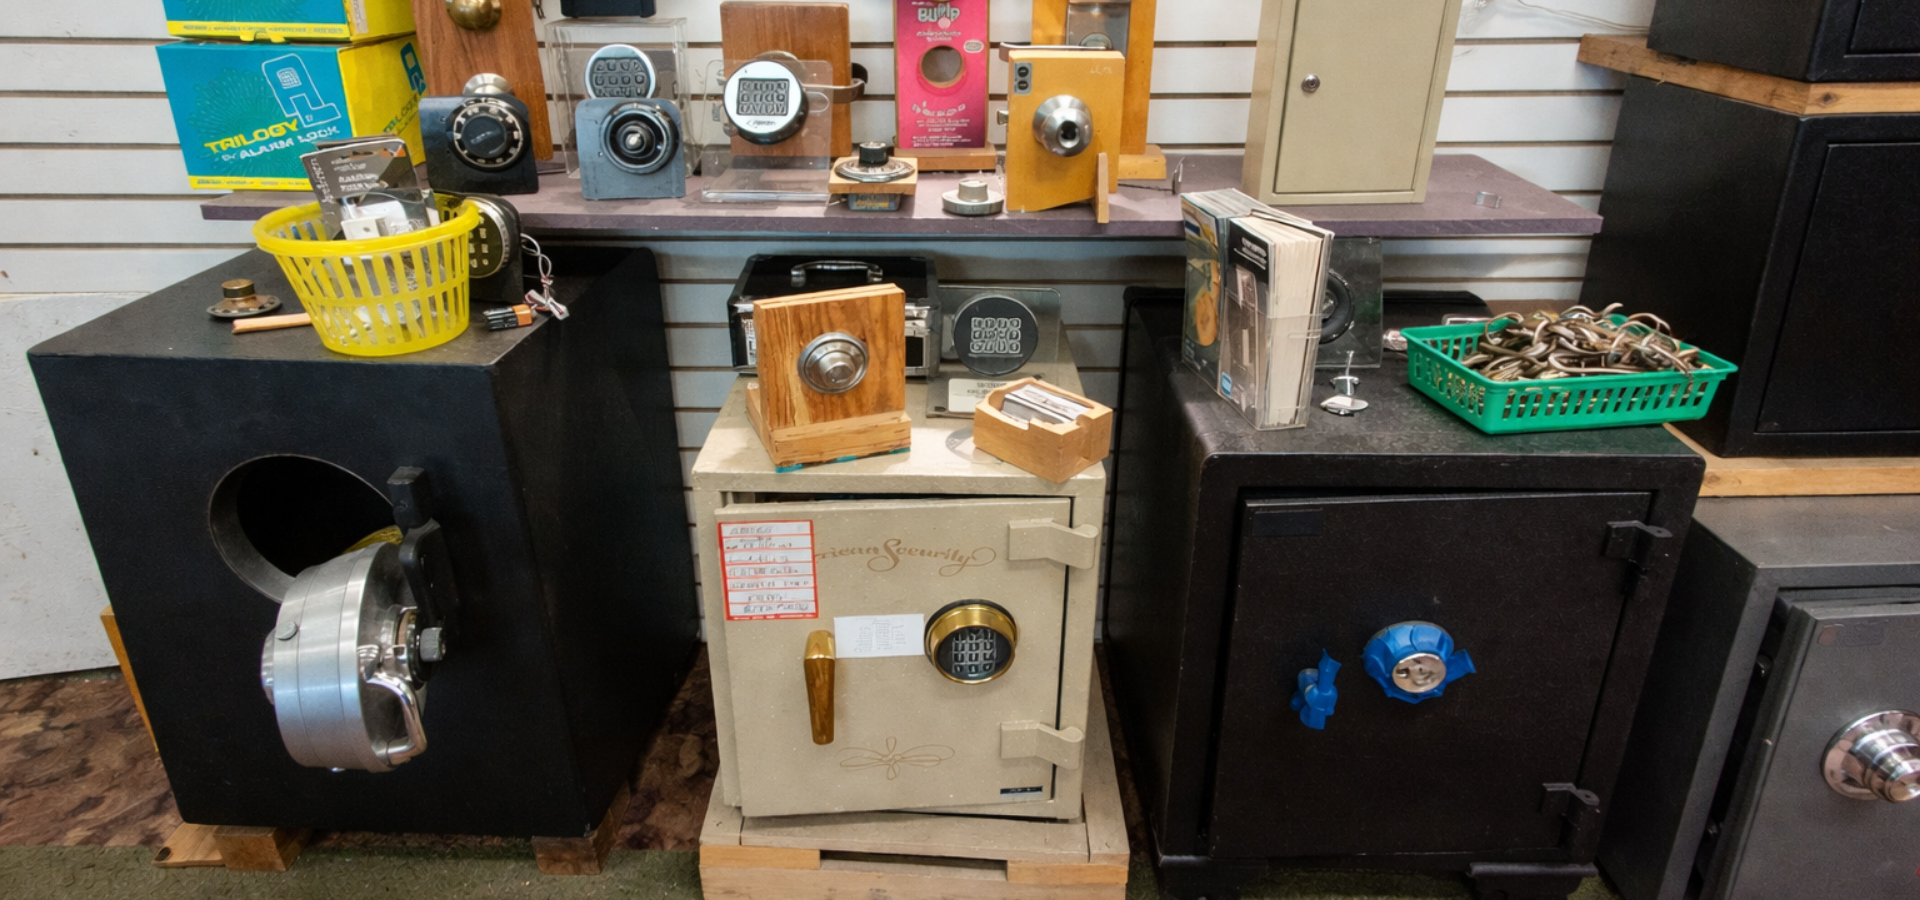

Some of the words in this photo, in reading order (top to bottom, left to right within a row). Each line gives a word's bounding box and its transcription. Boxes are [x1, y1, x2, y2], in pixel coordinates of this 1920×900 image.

[204, 118, 298, 153] TRILOGY
[239, 138, 294, 159] ALARM
[867, 539, 996, 577] Security
